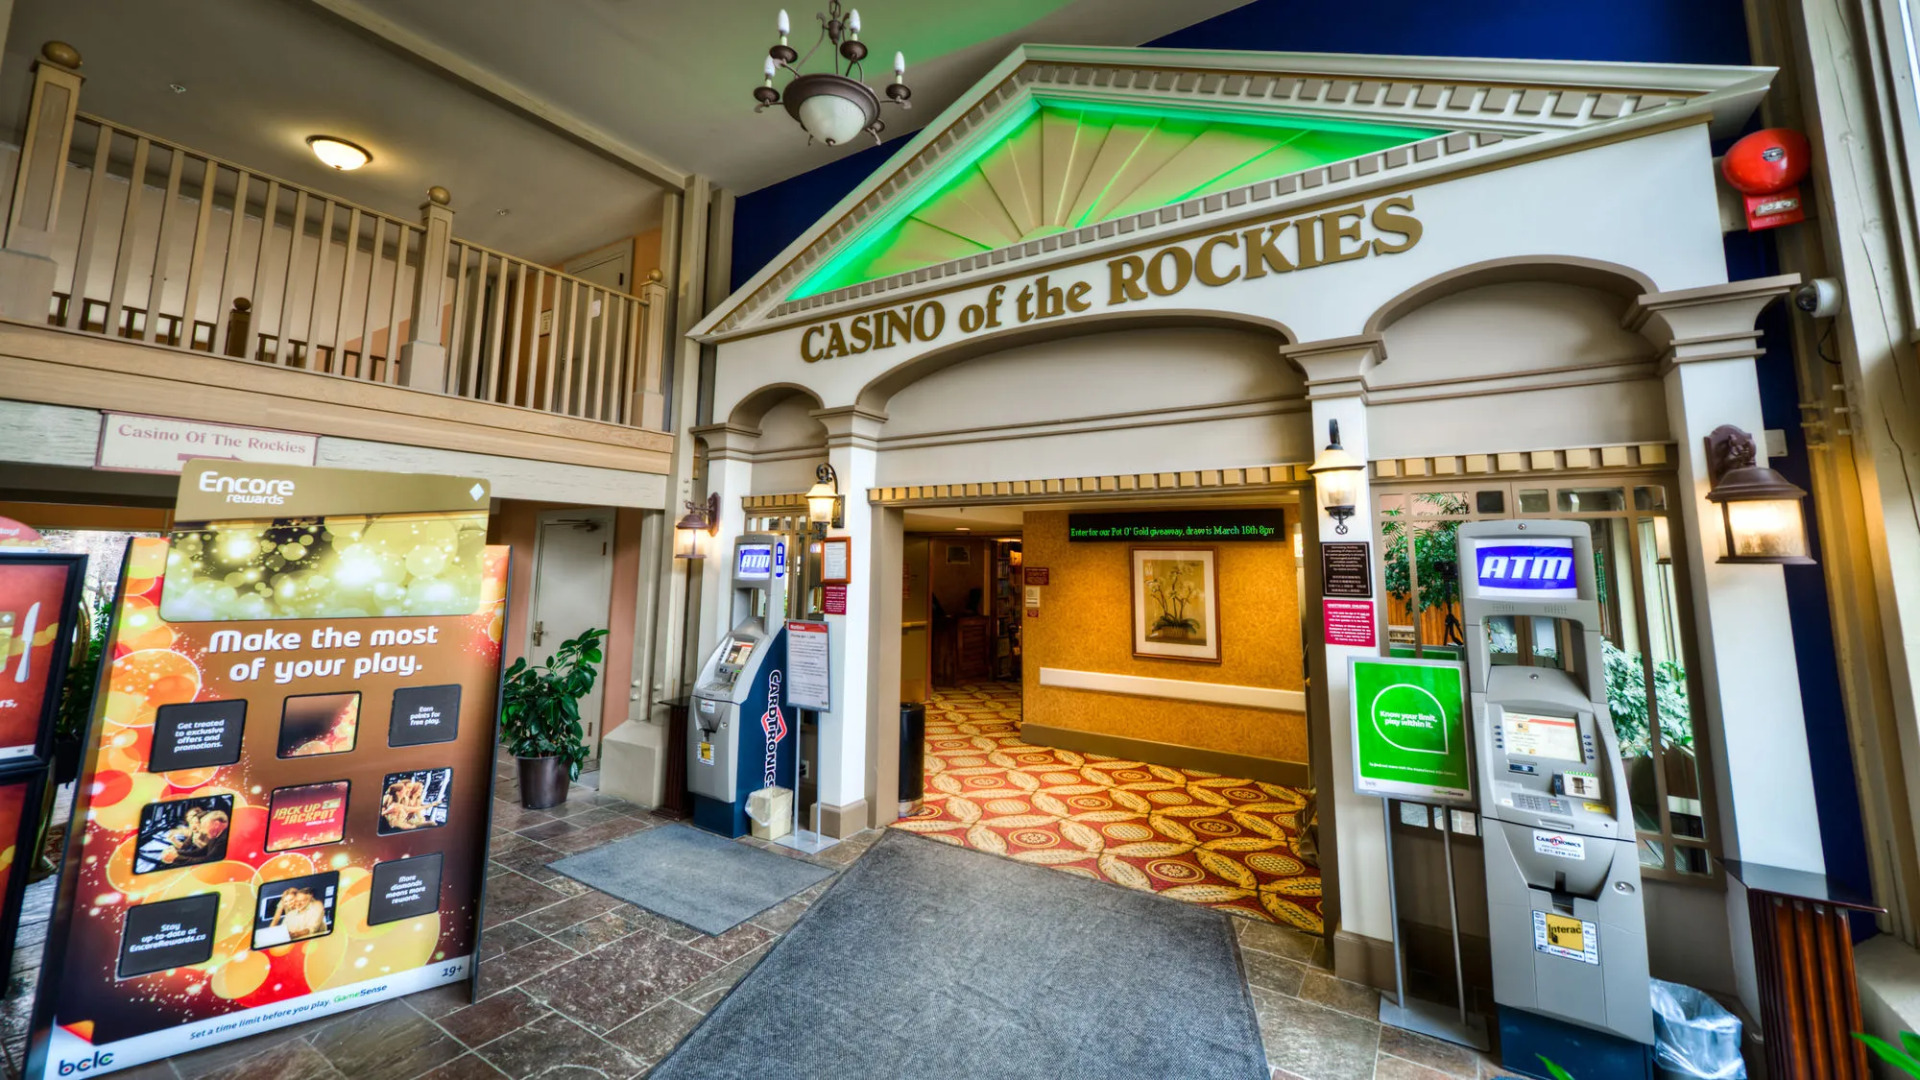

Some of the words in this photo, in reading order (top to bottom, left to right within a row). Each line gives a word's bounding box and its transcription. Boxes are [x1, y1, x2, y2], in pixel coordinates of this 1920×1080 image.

[801, 301, 945, 363] CASINO
[959, 284, 1006, 333] of
[1016, 275, 1092, 323] the
[1107, 195, 1423, 306] ROCKIES
[118, 424, 179, 442] Casino
[186, 431, 205, 444] Of
[212, 433, 242, 448] The
[248, 437, 306, 453] Rockies
[199, 470, 295, 496] Encore
[225, 493, 285, 505] rewards
[1070, 527, 1088, 536] Enter
[1089, 527, 1098, 536] for
[1099, 528, 1110, 536] our
[1111, 527, 1122, 536] Pot
[1133, 526, 1149, 536] Gold
[1150, 526, 1185, 537] giveaway,
[1186, 525, 1205, 536] draw
[1206, 525, 1212, 535] is
[1213, 525, 1240, 535] March
[741, 554, 770, 568] ATM
[775, 545, 784, 574] ATM
[1480, 556, 1572, 580] ATM
[208, 628, 302, 653] Make
[311, 627, 361, 649] the
[370, 625, 439, 646] most
[229, 657, 266, 682] of
[274, 658, 346, 684] your
[353, 652, 423, 680] play.
[410, 713, 430, 721] points
[1380, 710, 1400, 719] Know
[1401, 713, 1418, 721] your
[1418, 713, 1438, 723] limit,
[1384, 718, 1400, 727] play
[1401, 719, 1424, 728] within
[177, 722, 192, 730] Get
[194, 719, 225, 728] treated
[186, 727, 225, 736] exclusive
[177, 736, 203, 745] offers
[204, 733, 221, 742] and
[173, 742, 223, 754] promotions.
[273, 805, 303, 820] JACK
[303, 803, 321, 813] UP
[281, 808, 337, 826] JACKPOT
[390, 879, 423, 891] diamonds
[398, 875, 417, 883] More
[385, 889, 408, 899] means
[408, 886, 426, 894] more
[391, 894, 421, 905] rewards.
[160, 923, 182, 932] Stay
[1547, 924, 1582, 935] Interac
[141, 929, 186, 943] up-to-date
[188, 927, 198, 935] at
[442, 965, 464, 977] 19+
[190, 1029, 206, 1040] Set
[215, 1021, 238, 1033] time
[239, 1015, 261, 1028] limit
[262, 1008, 292, 1022] before
[292, 1003, 310, 1016] you
[311, 998, 331, 1012] play.
[333, 984, 388, 1003] GameSense
[58, 1050, 114, 1077] bclc
